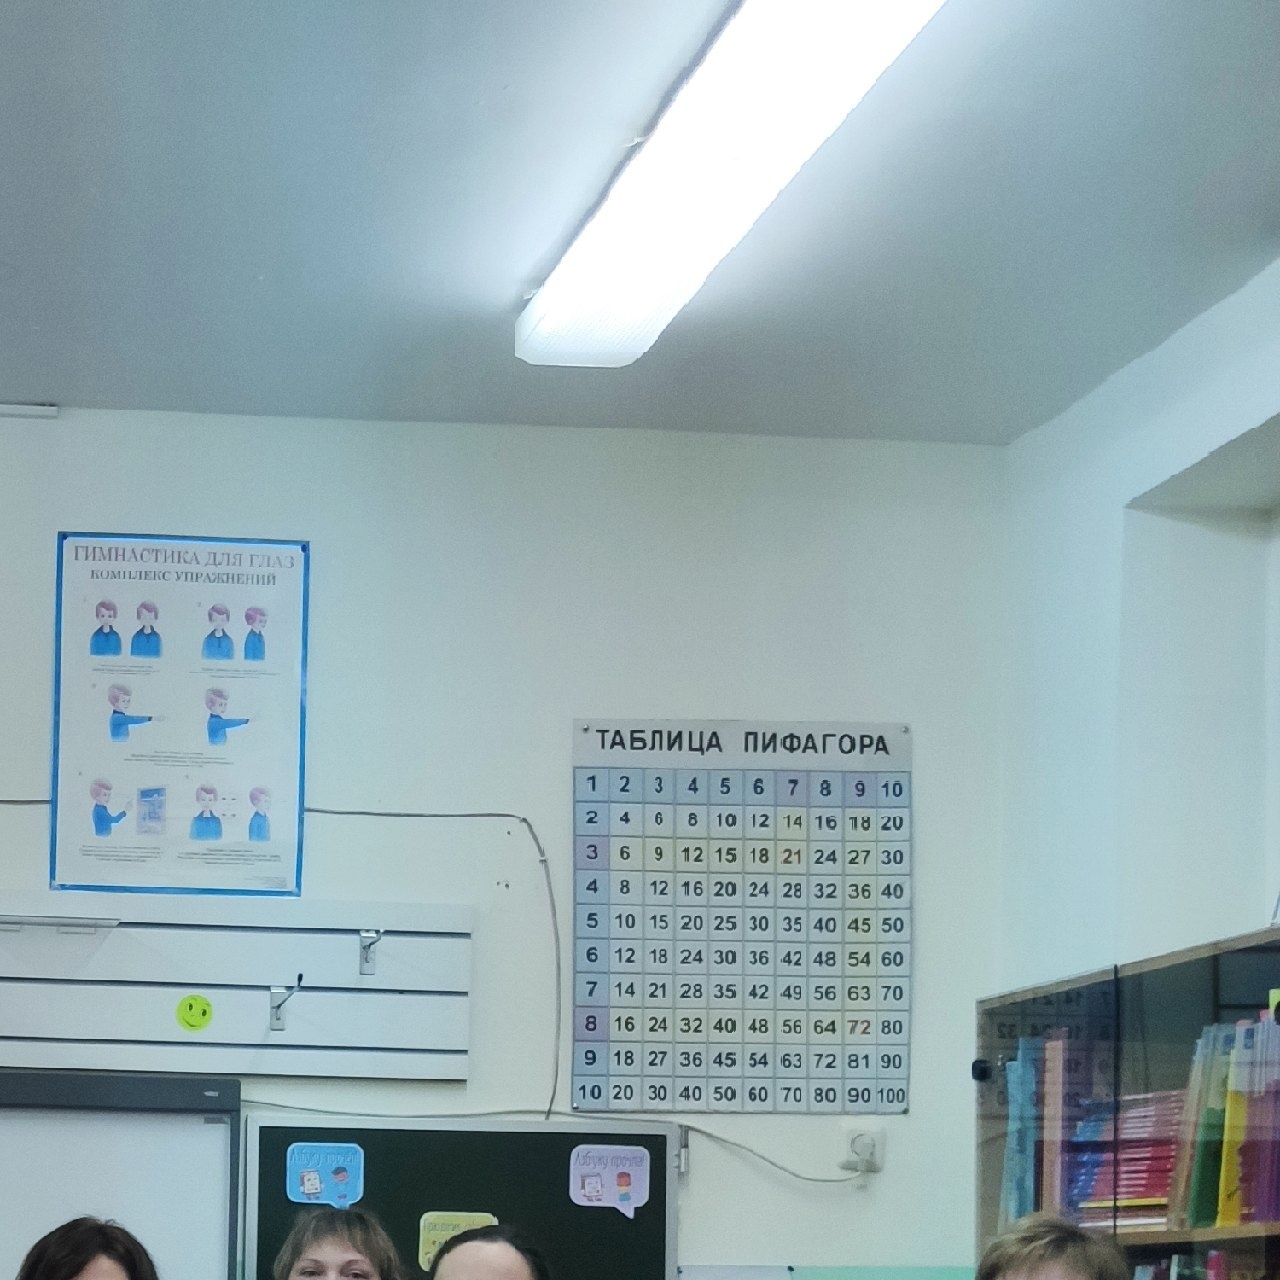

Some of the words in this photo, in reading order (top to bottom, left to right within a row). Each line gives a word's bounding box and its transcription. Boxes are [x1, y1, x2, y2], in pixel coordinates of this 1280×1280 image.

[74, 545, 200, 565] ГИМНАСТИКА
[204, 551, 243, 568] ДЛЯ
[249, 553, 295, 569] ГЛАЗ
[90, 569, 171, 582] КОМПЛЕКС
[175, 570, 276, 586] УПРАЖНЕНИЙ
[595, 729, 723, 756] ТАБЛИЦА
[743, 731, 890, 756] ПИФАГОРА
[586, 775, 596, 792] 1
[619, 775, 630, 793] 2
[654, 776, 663, 794] 3
[687, 776, 699, 794] 4
[719, 777, 731, 795] 5
[753, 777, 765, 795] 6
[787, 778, 799, 796] 7
[819, 779, 832, 797] 8
[854, 782, 865, 798] 9
[881, 782, 903, 798] 10
[585, 810, 598, 824] 2
[619, 811, 631, 824] 4
[654, 811, 664, 826] 6
[687, 812, 699, 827] 8
[716, 812, 737, 828] 10
[752, 813, 770, 828] 12
[782, 814, 802, 829] 14
[815, 815, 838, 831] 16
[848, 816, 871, 832] 18
[880, 816, 904, 832] 20
[586, 844, 598, 860] 3
[619, 845, 631, 861] 6
[654, 846, 663, 862] 9
[681, 846, 703, 863] 12
[715, 847, 737, 864] 15
[750, 847, 770, 864] 18
[782, 848, 801, 865] 21
[814, 849, 838, 865] 24
[847, 849, 871, 865] 27
[880, 849, 904, 865] 30
[585, 878, 598, 894] 4
[619, 879, 631, 895] 8
[650, 880, 669, 896] 12
[681, 880, 704, 897] 16
[713, 880, 737, 897] 20
[749, 881, 770, 898] 24
[782, 882, 802, 899] 28
[813, 882, 837, 899] 32
[848, 883, 871, 900] 36
[880, 883, 904, 900] 40
[586, 912, 599, 929] 5
[614, 913, 636, 929] 10
[649, 914, 669, 930] 15
[680, 915, 704, 931] 20
[713, 915, 737, 931] 25
[749, 915, 769, 932] 30
[782, 915, 802, 933] 35
[813, 917, 837, 933] 40
[847, 917, 871, 934] 45
[881, 916, 905, 934] 50
[586, 946, 599, 963] 6
[614, 947, 636, 964] 12
[649, 948, 668, 964] 18
[679, 949, 704, 965] 24
[713, 949, 737, 965] 30
[749, 950, 770, 966] 36
[782, 950, 802, 967] 42
[812, 950, 837, 967] 48
[848, 951, 871, 968] 54
[880, 950, 904, 967] 60
[585, 980, 598, 997] 7
[614, 981, 636, 998] 14
[648, 982, 667, 999] 21
[679, 983, 703, 999] 28
[713, 983, 737, 999] 35
[748, 984, 769, 1000] 42
[782, 985, 802, 1001] 49
[813, 985, 837, 1001] 56
[847, 985, 871, 1002] 63
[880, 985, 904, 1001] 70
[584, 1015, 597, 1032] 8
[614, 1015, 635, 1033] 16
[648, 1016, 668, 1033] 24
[679, 1017, 703, 1034] 32
[712, 1017, 737, 1034] 40
[748, 1018, 769, 1034] 48
[782, 1019, 802, 1035] 56
[813, 1019, 837, 1035] 64
[846, 1019, 871, 1035] 72
[880, 1019, 903, 1035] 80
[584, 1049, 597, 1066] 9
[613, 1049, 635, 1067] 18
[648, 1050, 668, 1067] 27
[679, 1051, 703, 1068] 36
[712, 1051, 737, 1068] 45
[749, 1052, 769, 1068] 54
[780, 1053, 802, 1069] 63
[813, 1053, 837, 1069] 72
[847, 1053, 870, 1069] 81
[880, 1053, 902, 1069] 90
[578, 1084, 602, 1100] 10
[612, 1084, 634, 1101] 20
[648, 1084, 667, 1101] 30
[678, 1085, 702, 1102] 40
[713, 1085, 737, 1102] 50
[748, 1086, 768, 1103] 60
[782, 1086, 802, 1103] 70
[814, 1087, 837, 1104] 80
[847, 1087, 871, 1104] 90
[877, 1087, 906, 1104] 100
